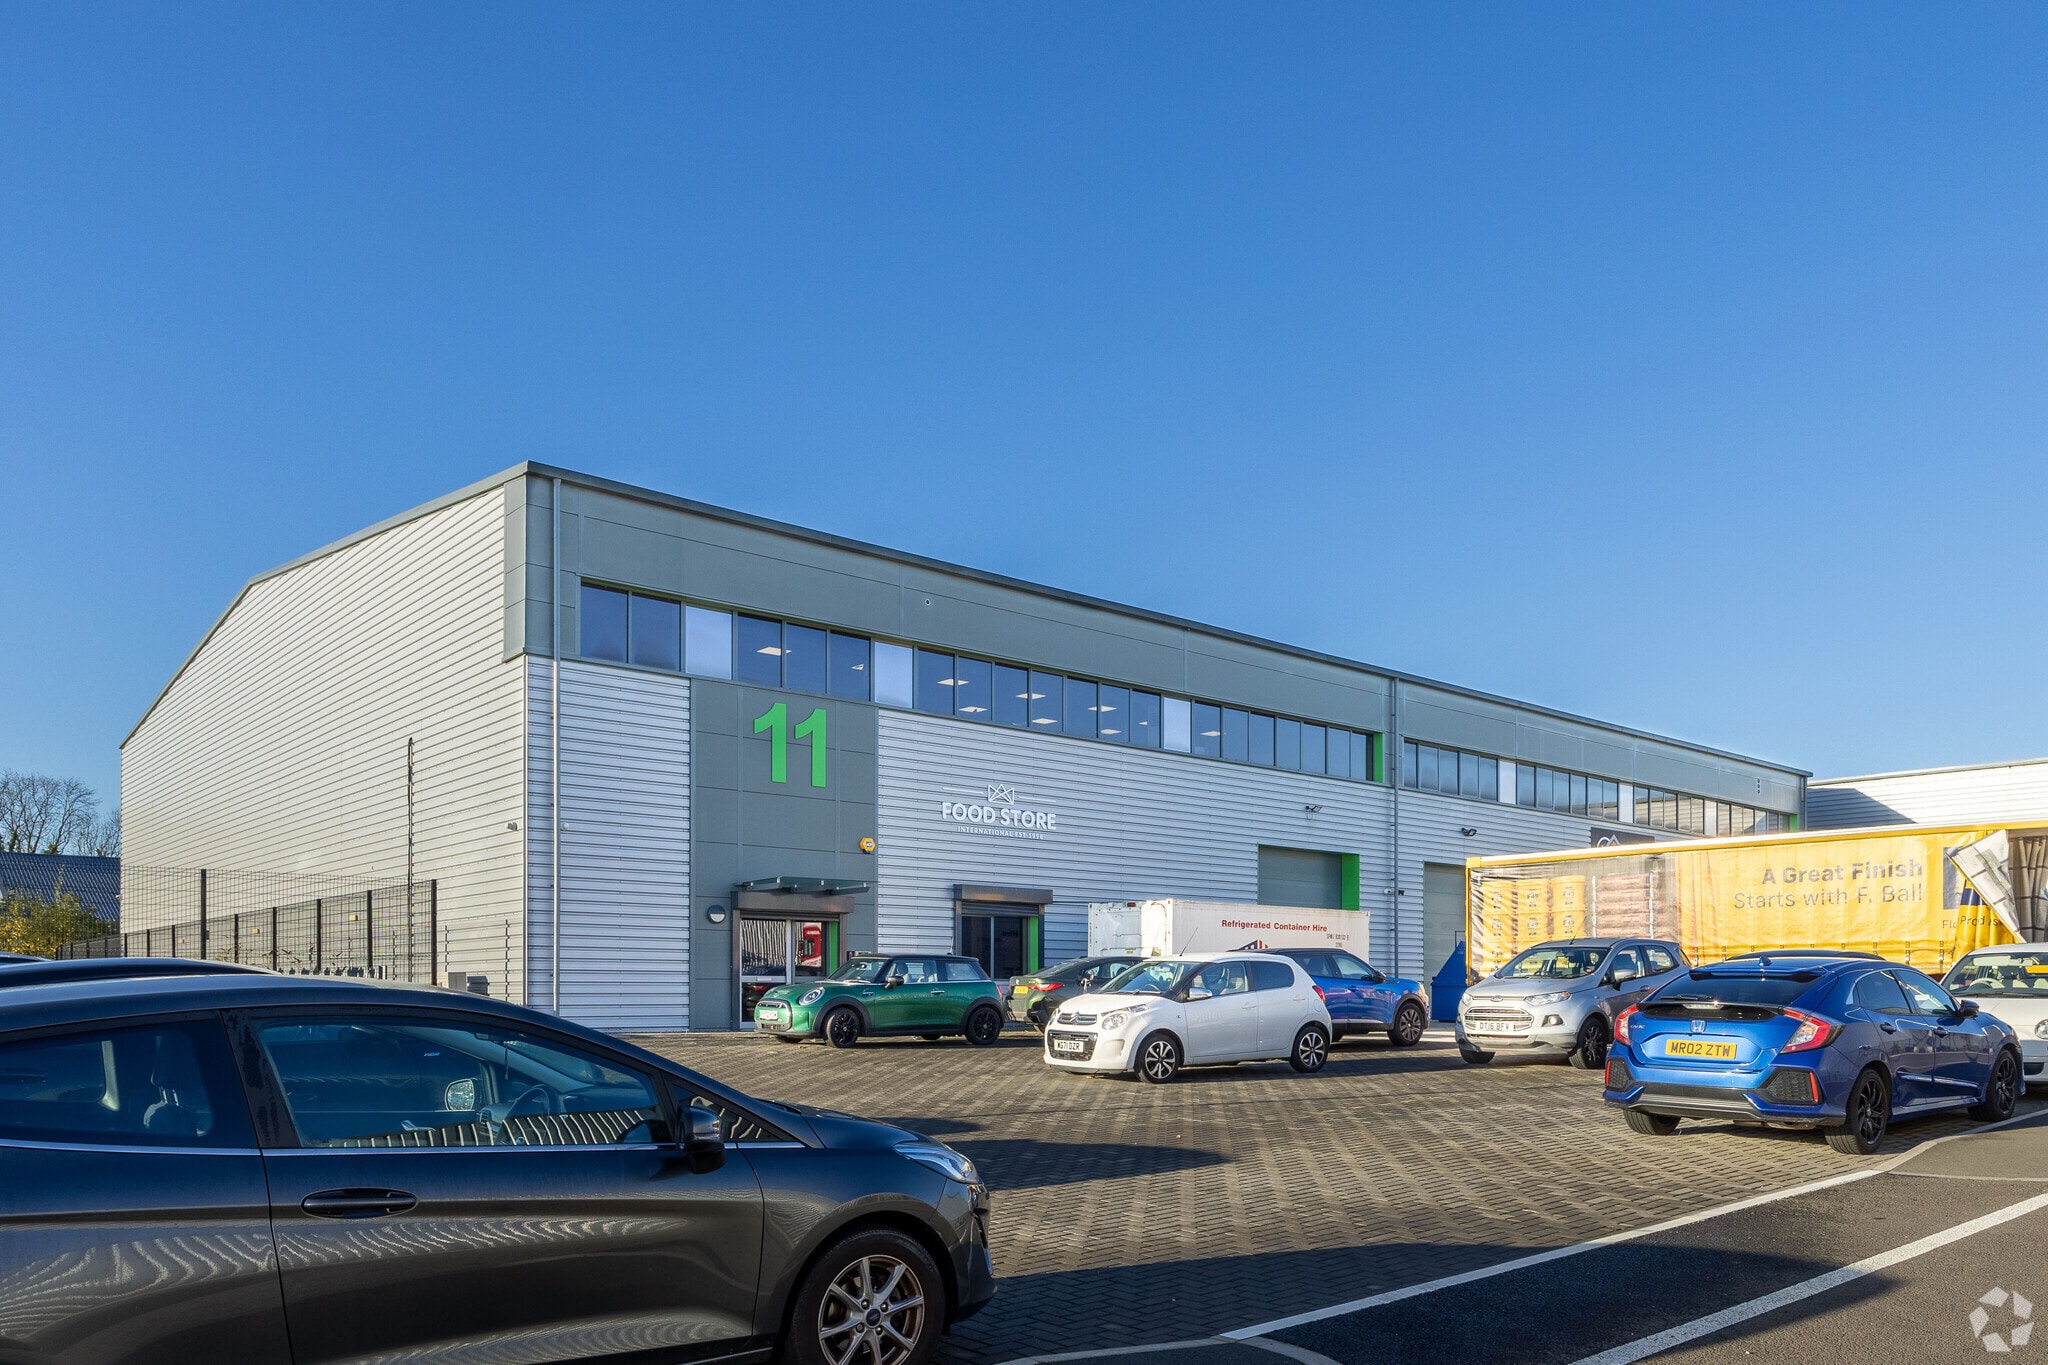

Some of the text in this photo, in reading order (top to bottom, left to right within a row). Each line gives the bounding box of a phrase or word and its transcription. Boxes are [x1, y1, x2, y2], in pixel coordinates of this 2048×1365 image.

[753, 702, 827, 788] 11
[942, 801, 1057, 830] FOOD STORE
[957, 826, 1012, 837] INTERNATIONAL
[1761, 859, 1922, 885] A Great Finish
[1734, 892, 1796, 909] Starts
[1803, 888, 1848, 906] with
[1882, 883, 1923, 903] Ball
[1221, 919, 1328, 932] Refrigerated Container Hire
[1670, 1042, 1731, 1057] MR02 ZTW
